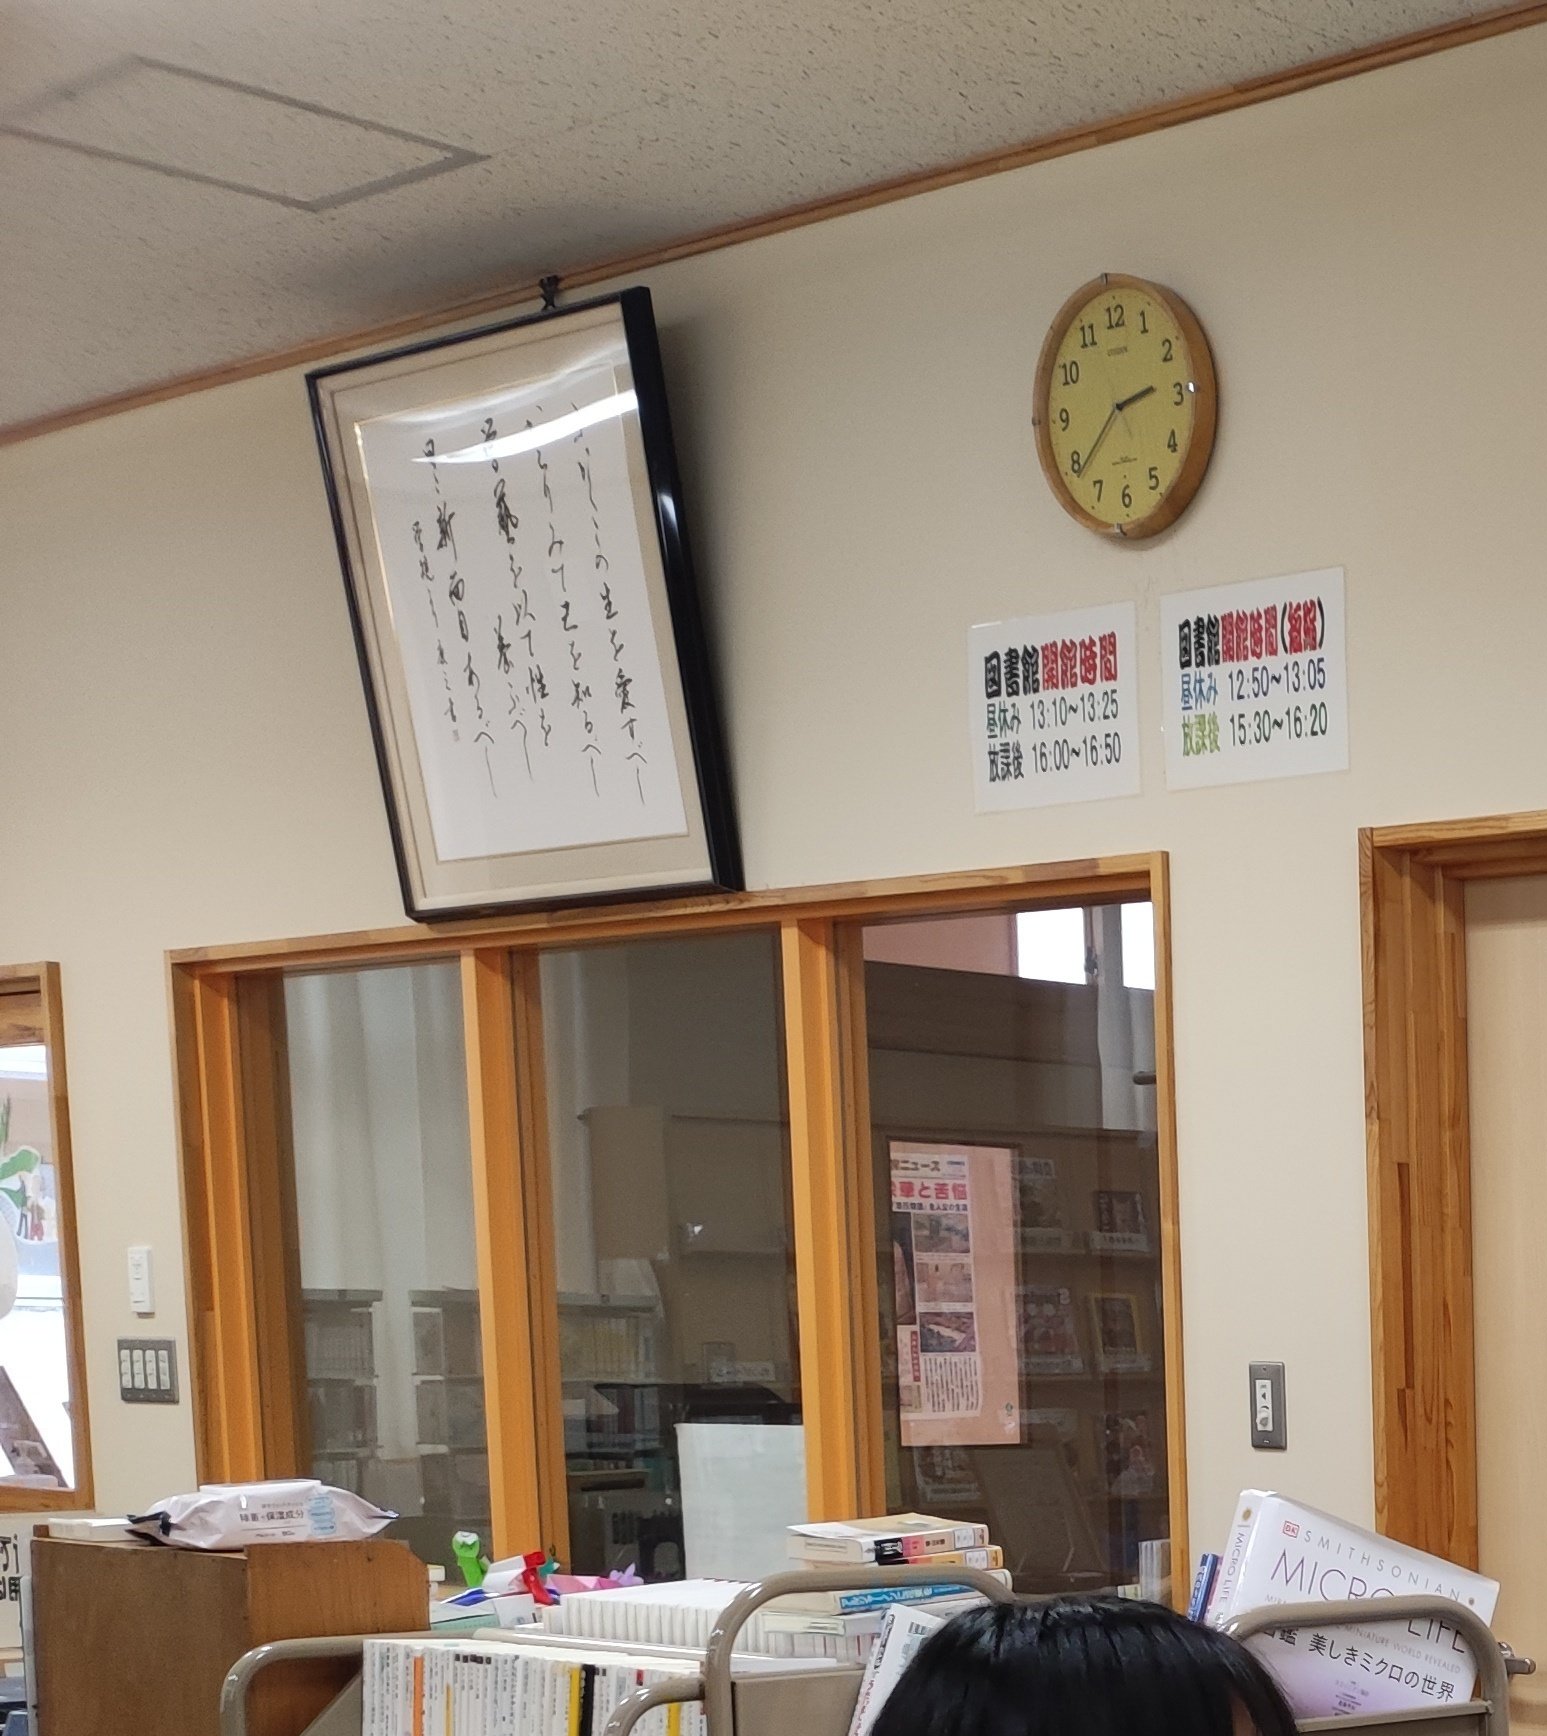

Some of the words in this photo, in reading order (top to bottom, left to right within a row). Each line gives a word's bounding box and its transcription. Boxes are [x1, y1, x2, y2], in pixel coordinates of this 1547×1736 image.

[1105, 305, 1125, 330] 12
[1139, 310, 1149, 334] 1
[1080, 322, 1097, 349] 11
[1162, 339, 1173, 363] 2
[1060, 361, 1080, 385] 10
[1173, 382, 1184, 406] 3
[1060, 409, 1070, 431] 9
[1167, 430, 1178, 453] 4
[1071, 451, 1081, 473] 8
[1148, 466, 1160, 490] 5
[1093, 479, 1103, 503] 7
[1122, 485, 1132, 508] 6
[984, 631, 1119, 700] 図書館開館時間
[1179, 670, 1220, 713] 昼休み
[985, 701, 1022, 740] 昼休み
[1181, 713, 1222, 758] 放課後
[988, 743, 1025, 784] 放課後
[1283, 1520, 1300, 1539] DK
[1303, 1529, 1461, 1602] SMITHSONIAN
[1308, 1633, 1456, 1703] 美しきミクロの世界
